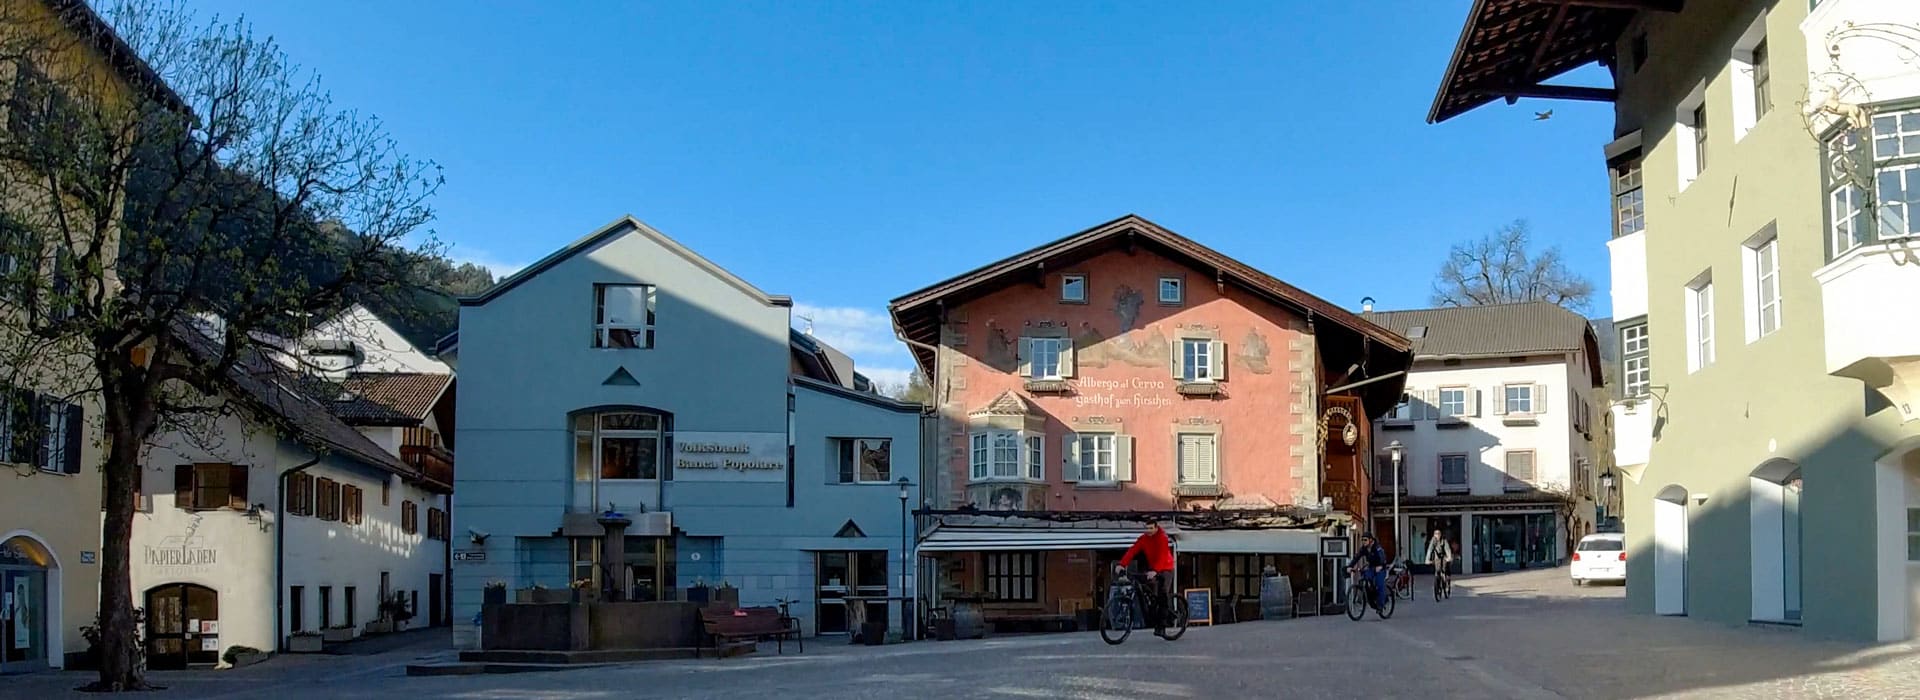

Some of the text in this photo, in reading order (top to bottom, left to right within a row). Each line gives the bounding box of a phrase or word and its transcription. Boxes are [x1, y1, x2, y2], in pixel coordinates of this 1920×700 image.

[1077, 376, 1119, 390] Albergo
[1132, 377, 1164, 389] Cervo
[1075, 393, 1114, 409] Gasthof
[679, 442, 750, 453] Volksbank
[677, 459, 784, 472] Banca Popolare
